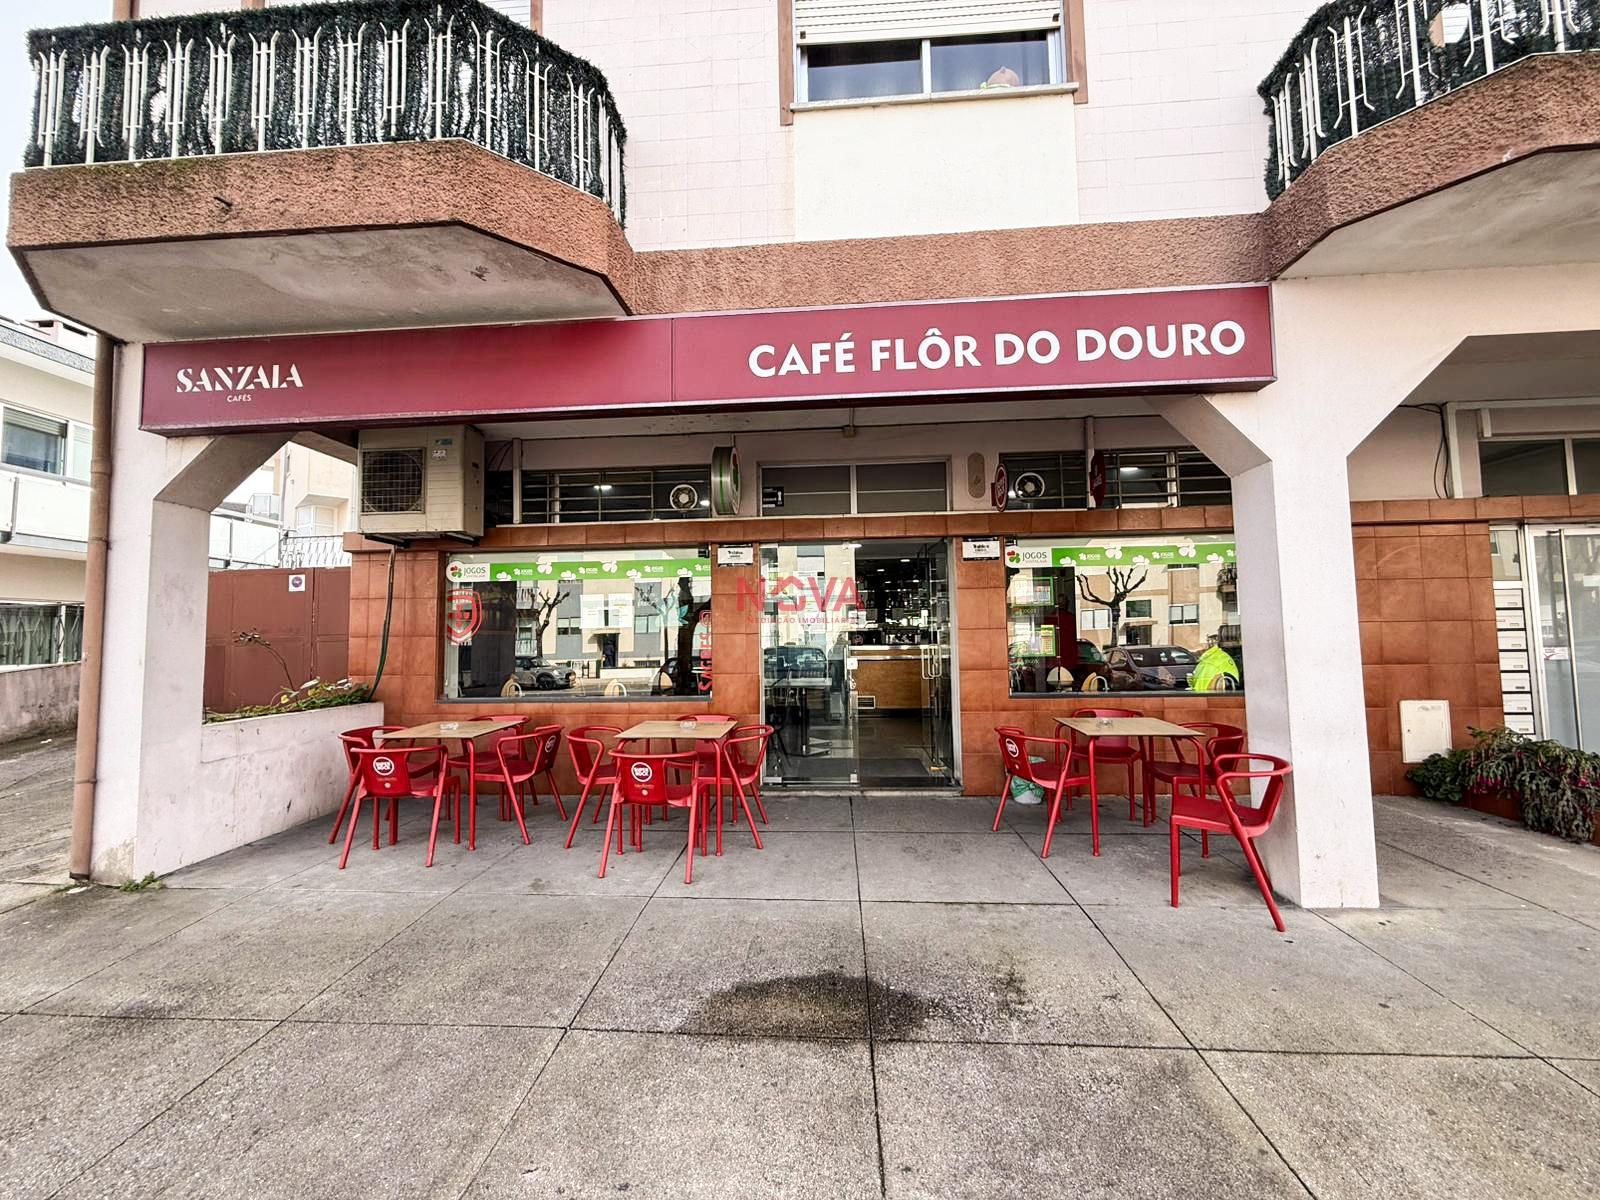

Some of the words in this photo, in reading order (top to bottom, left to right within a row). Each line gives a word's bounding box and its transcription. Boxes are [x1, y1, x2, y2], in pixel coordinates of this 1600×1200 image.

[749, 330, 856, 379] CAFÉ
[871, 327, 981, 371] FLÔR
[994, 330, 1061, 366] DO
[1076, 320, 1247, 362] DOURO
[176, 363, 304, 393] SANZALA
[1022, 551, 1047, 561] JOGOS
[463, 567, 486, 576] JOGOS
